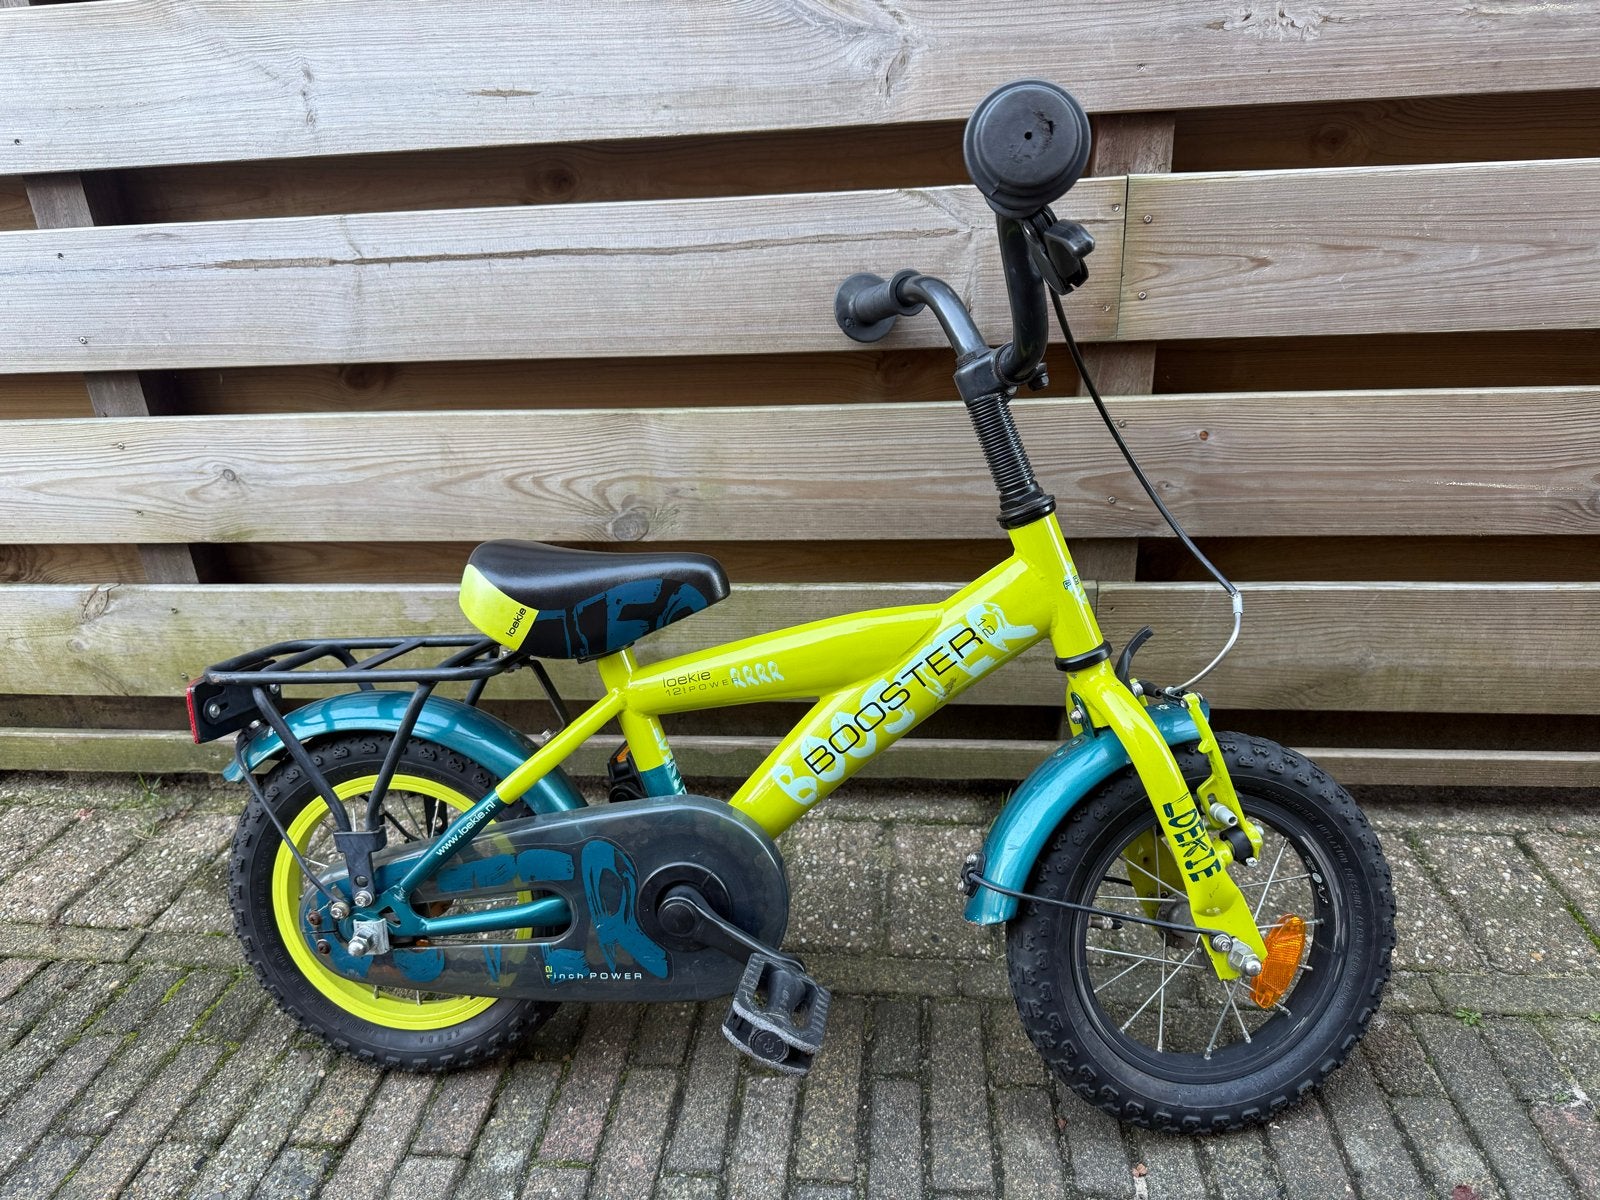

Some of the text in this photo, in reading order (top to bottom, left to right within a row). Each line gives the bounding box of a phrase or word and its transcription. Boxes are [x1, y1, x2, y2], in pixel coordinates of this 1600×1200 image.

[506, 607, 527, 638] loekie
[662, 670, 711, 688] loekie
[804, 627, 984, 775] BOOSTER
[436, 801, 496, 856] www.loekie.nl
[553, 972, 584, 980] inch
[589, 972, 642, 980] POWER
